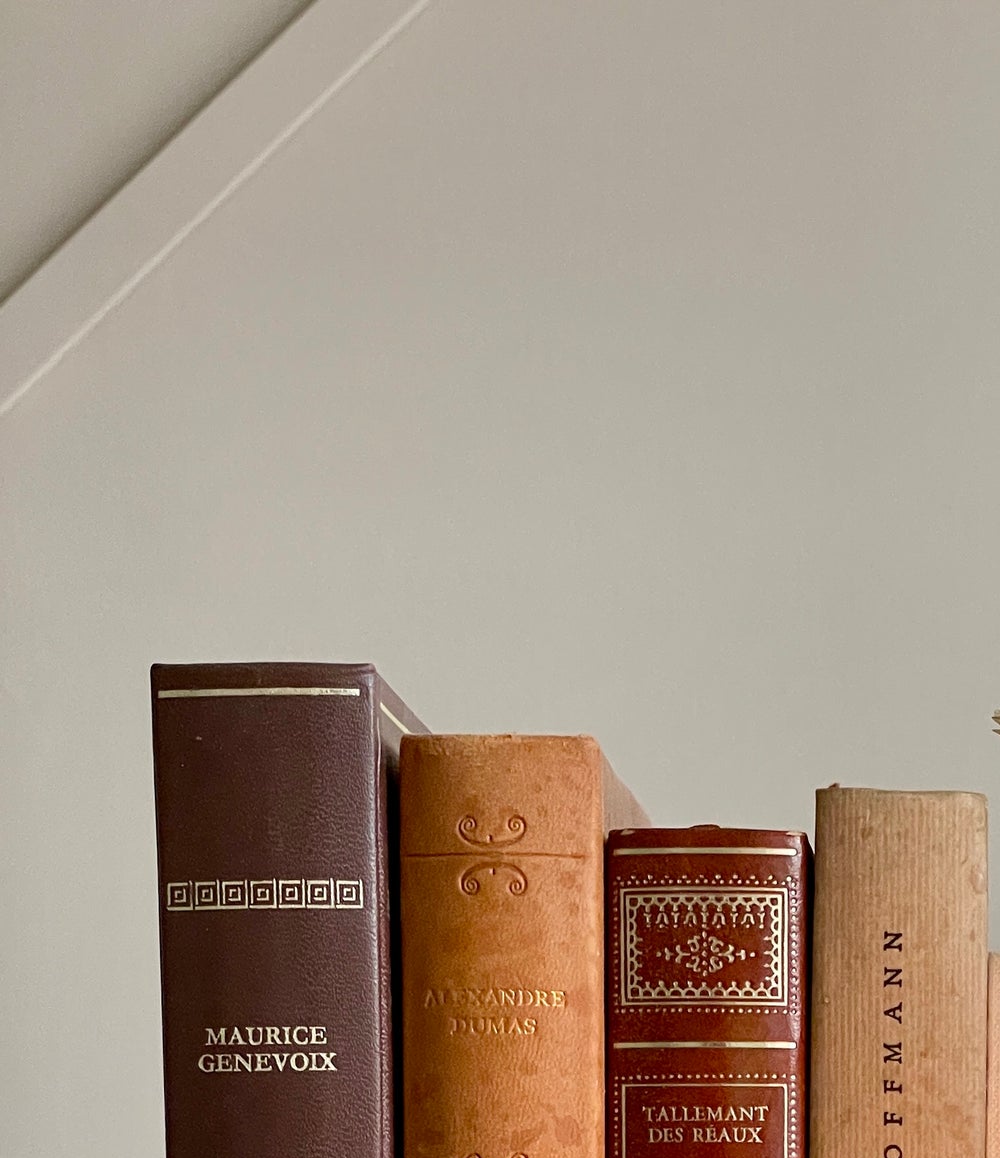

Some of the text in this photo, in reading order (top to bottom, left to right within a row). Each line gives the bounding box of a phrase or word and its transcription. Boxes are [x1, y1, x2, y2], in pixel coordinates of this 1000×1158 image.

[424, 988, 566, 1008] ALEXANDRE
[204, 1026, 328, 1046] MAURICE
[449, 1017, 538, 1035] DUMAS
[197, 1052, 338, 1073] GENEVOIX
[642, 1105, 770, 1122] TALLEMANT
[648, 1124, 764, 1144] DES RÉAUX
